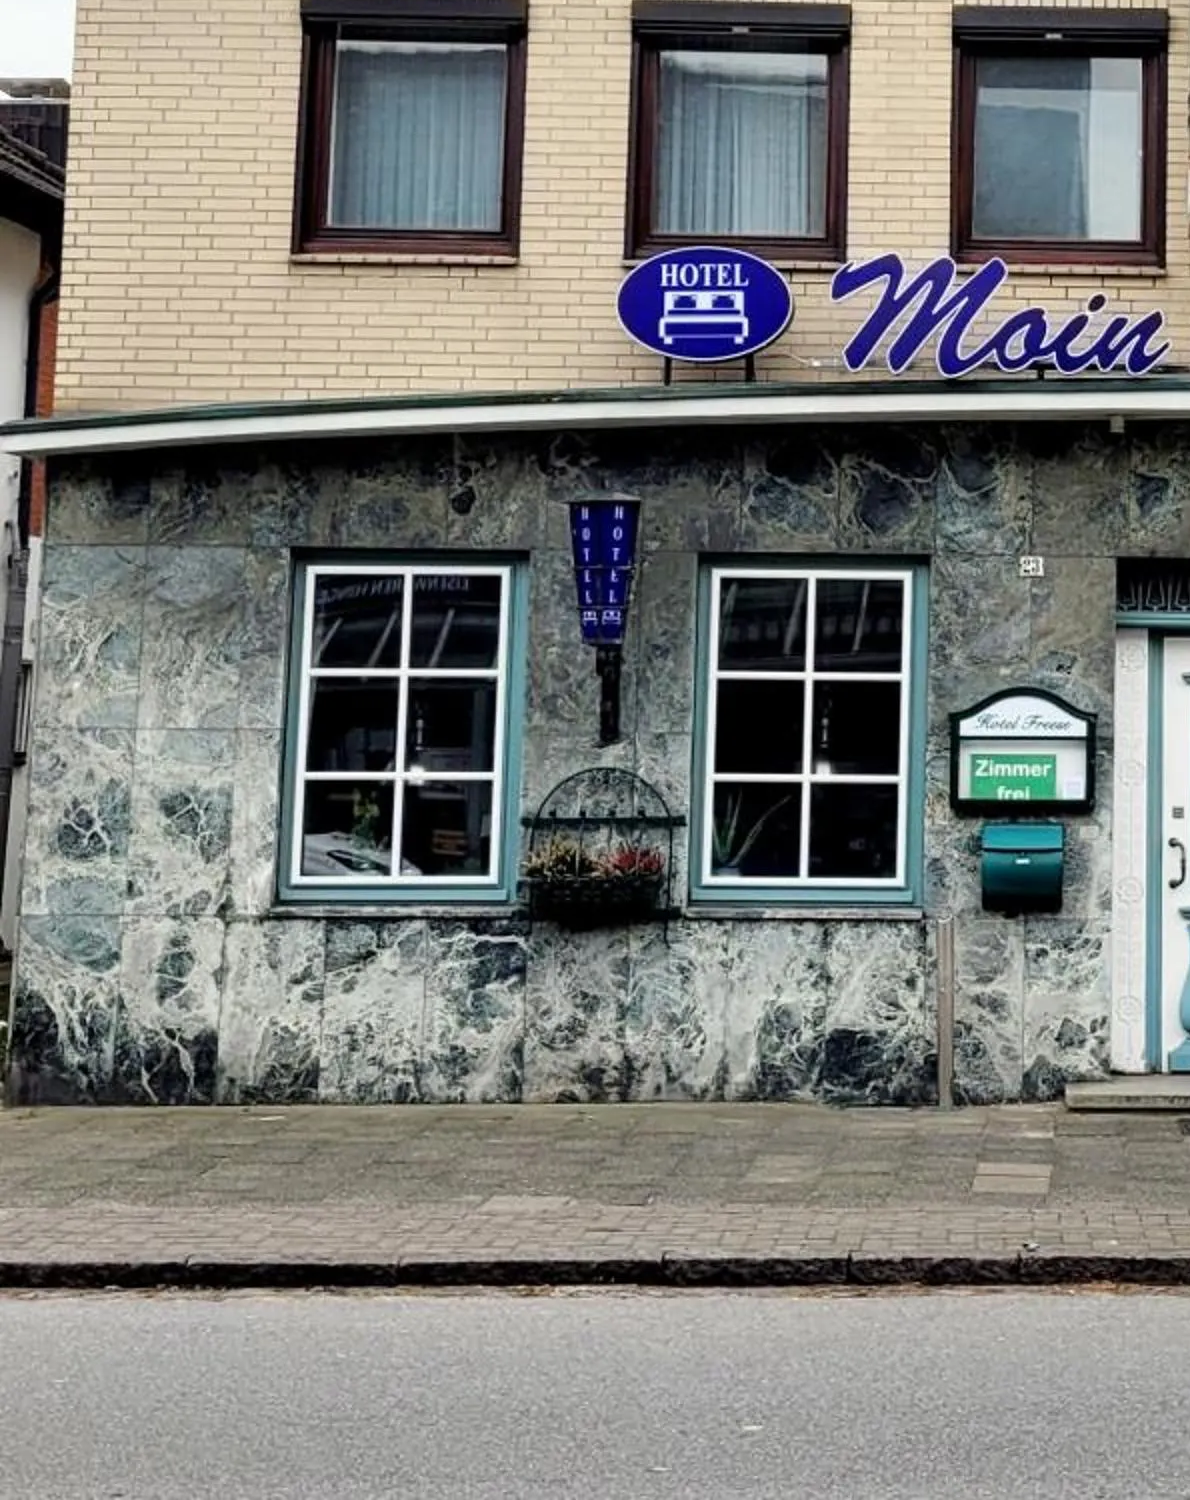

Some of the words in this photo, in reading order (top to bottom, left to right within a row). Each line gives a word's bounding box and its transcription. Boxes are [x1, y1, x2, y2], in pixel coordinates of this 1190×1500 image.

[660, 262, 749, 287] HOTEL
[831, 252, 1171, 377] Moin
[975, 759, 1052, 777] Zimmer
[997, 785, 1031, 800] frei
